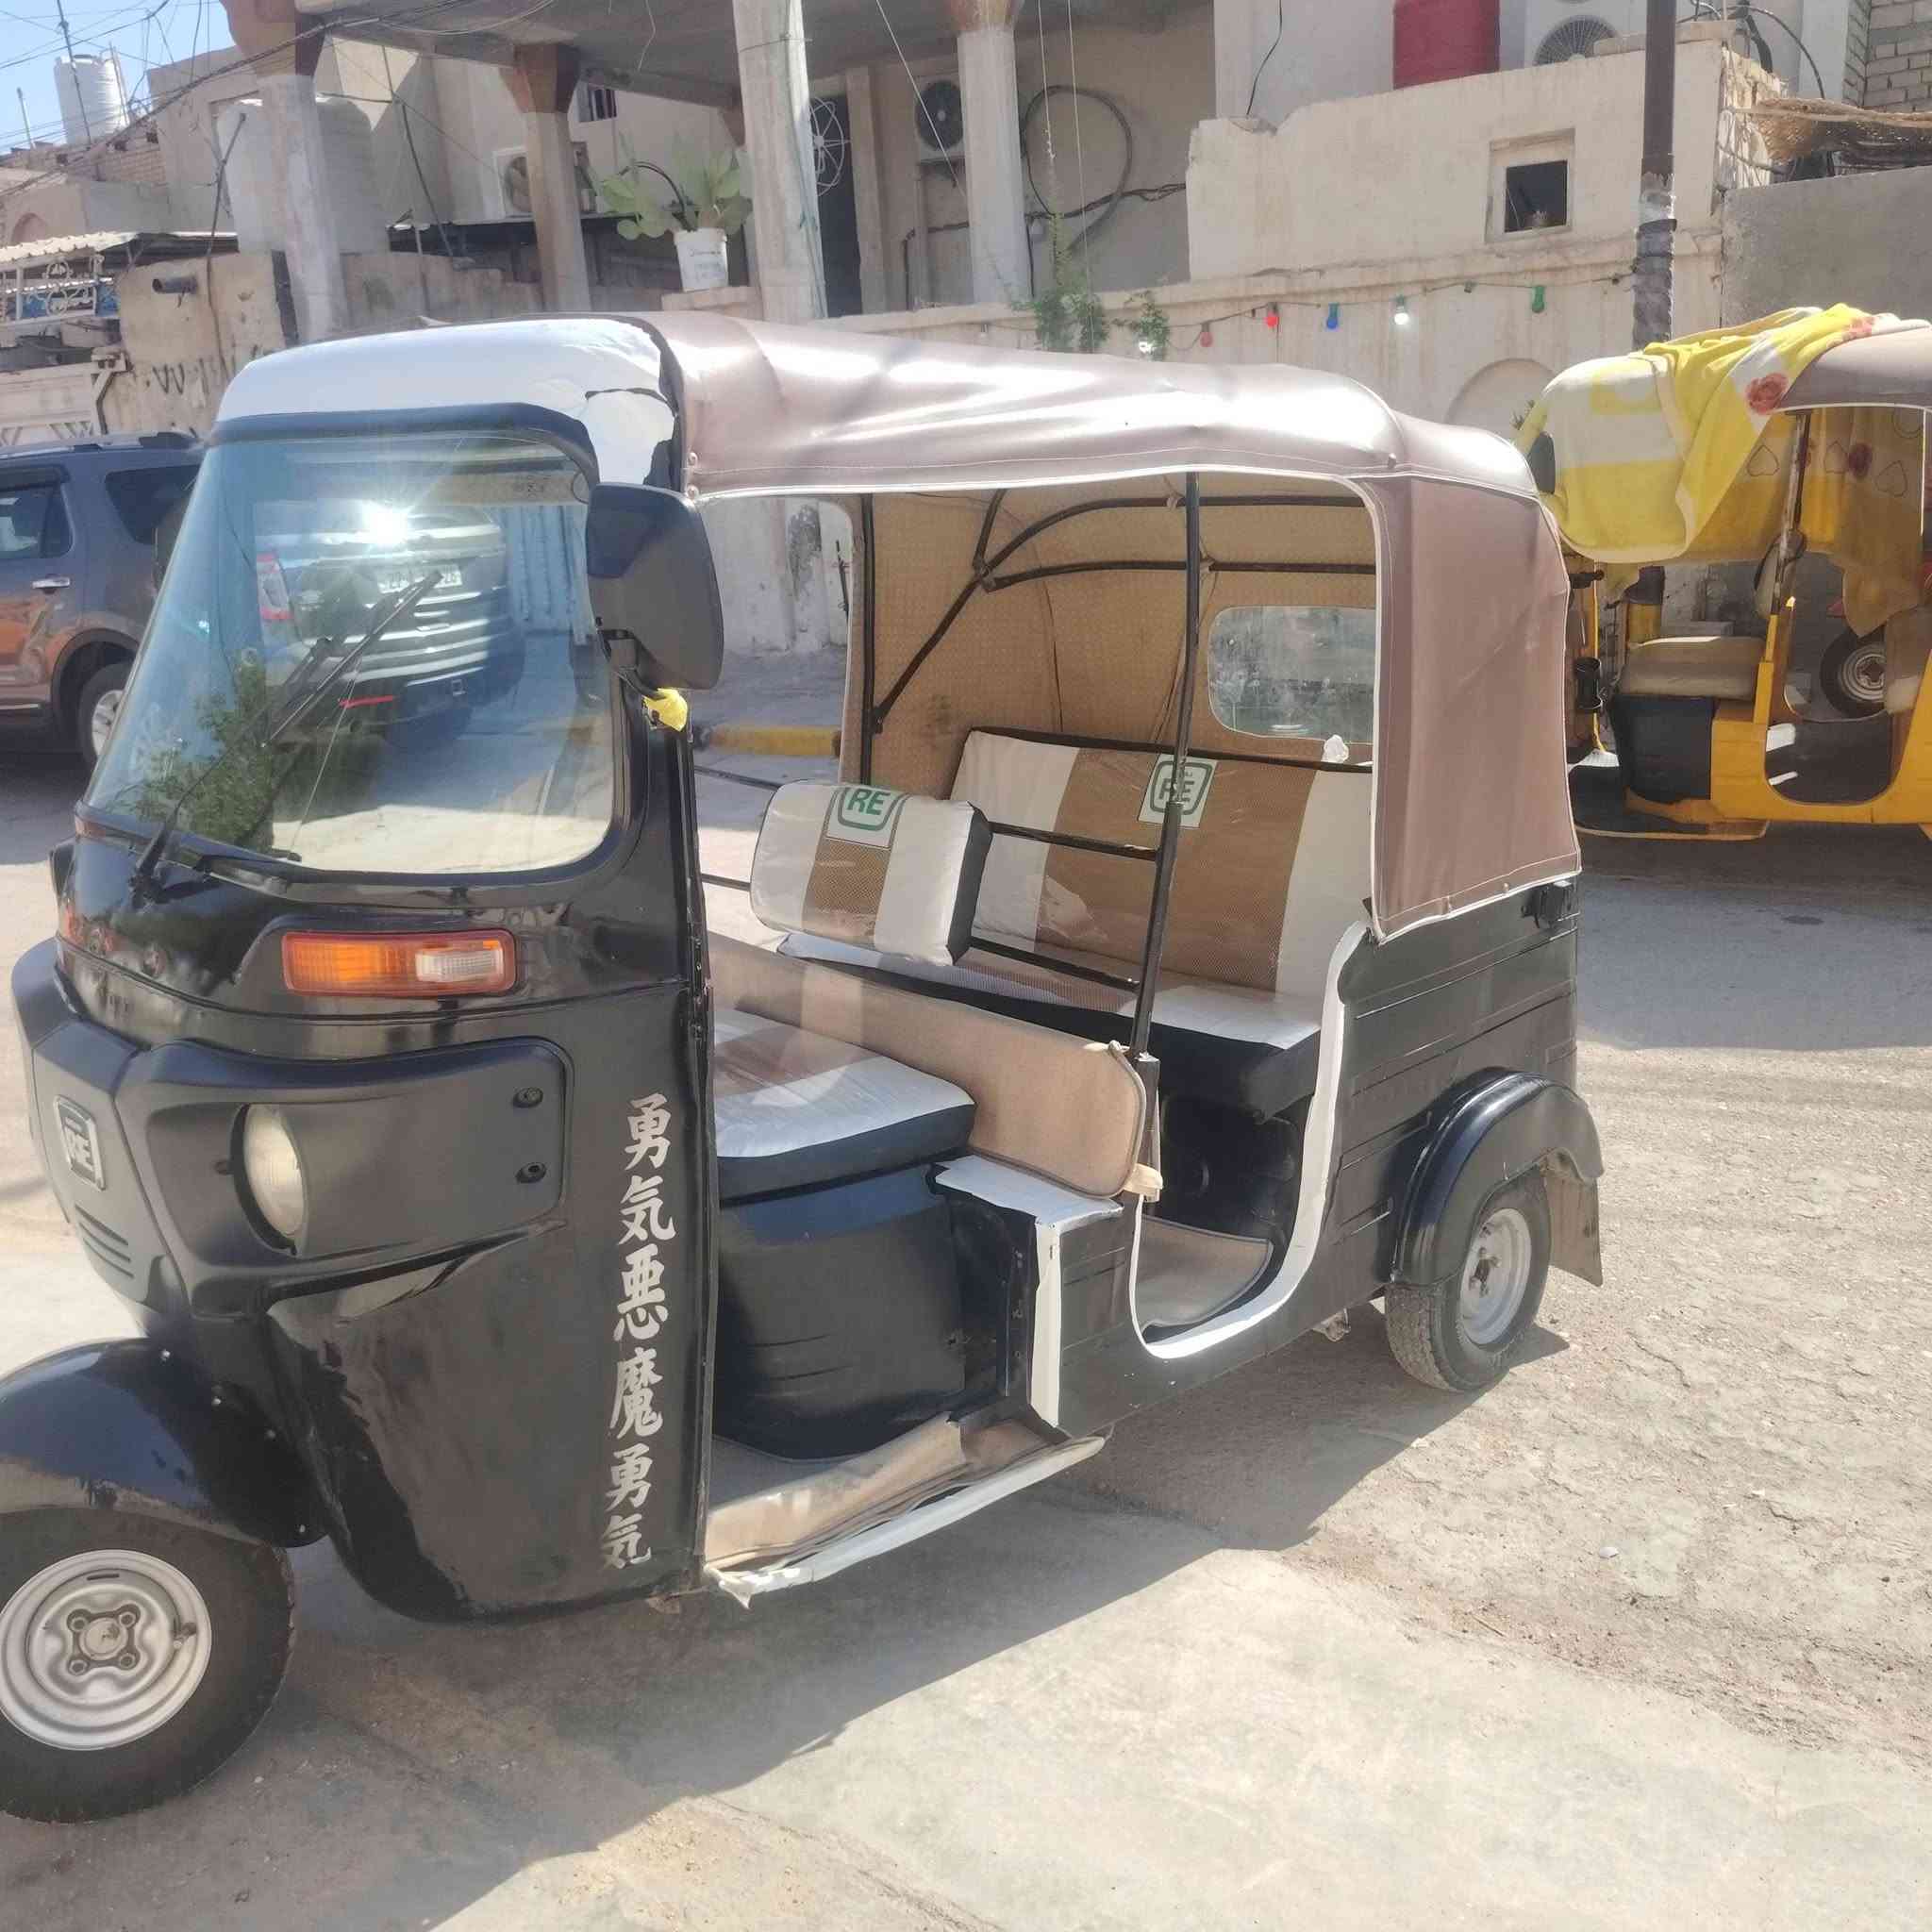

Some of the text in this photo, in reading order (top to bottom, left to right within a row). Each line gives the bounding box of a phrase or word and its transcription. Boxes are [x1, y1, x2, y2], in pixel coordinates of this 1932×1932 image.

[846, 787, 891, 815] RE
[600, 1092, 676, 1570] 勇気悪魔勇気
